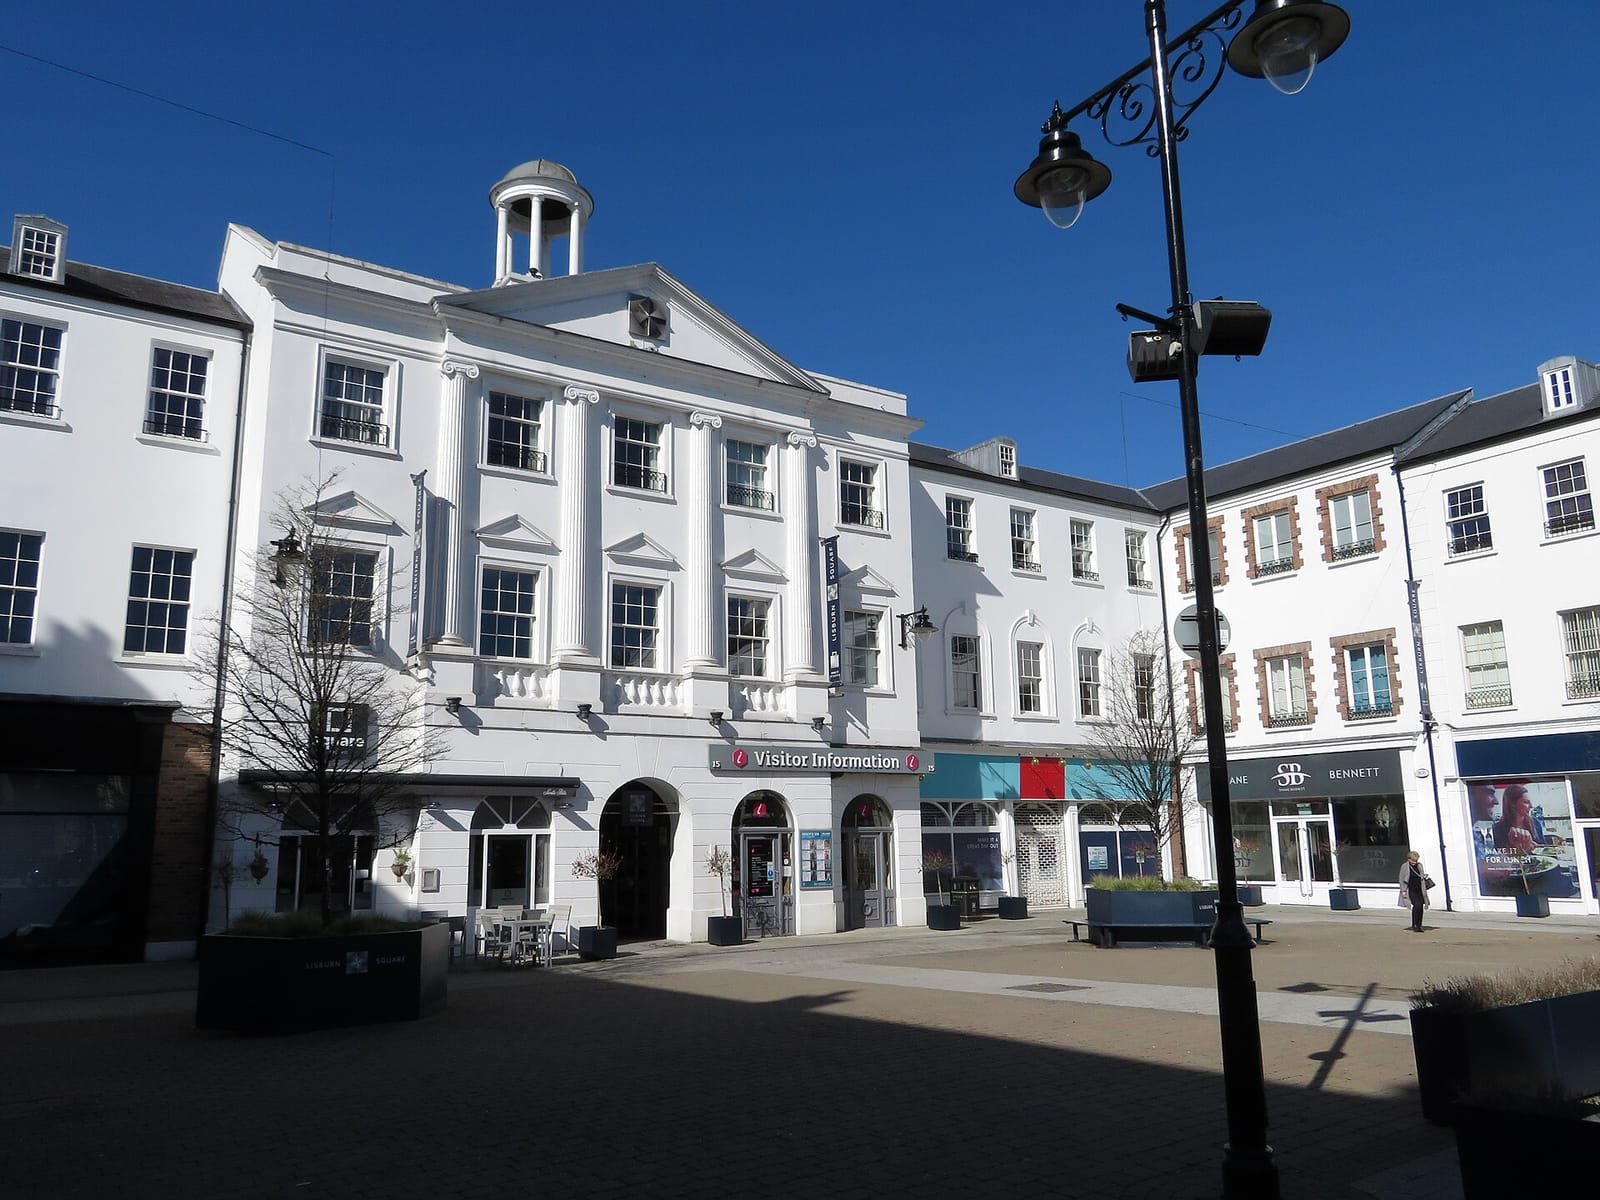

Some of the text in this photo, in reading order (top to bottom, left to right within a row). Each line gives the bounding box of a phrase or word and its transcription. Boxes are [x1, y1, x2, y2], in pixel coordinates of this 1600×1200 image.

[712, 760, 721, 769] 15
[754, 750, 809, 768] Visitor
[812, 752, 900, 770] Information
[1229, 767, 1380, 786] ANE BENNETT
[1485, 847, 1518, 855] MAKE IT
[1486, 855, 1532, 864] FOR LUNCH
